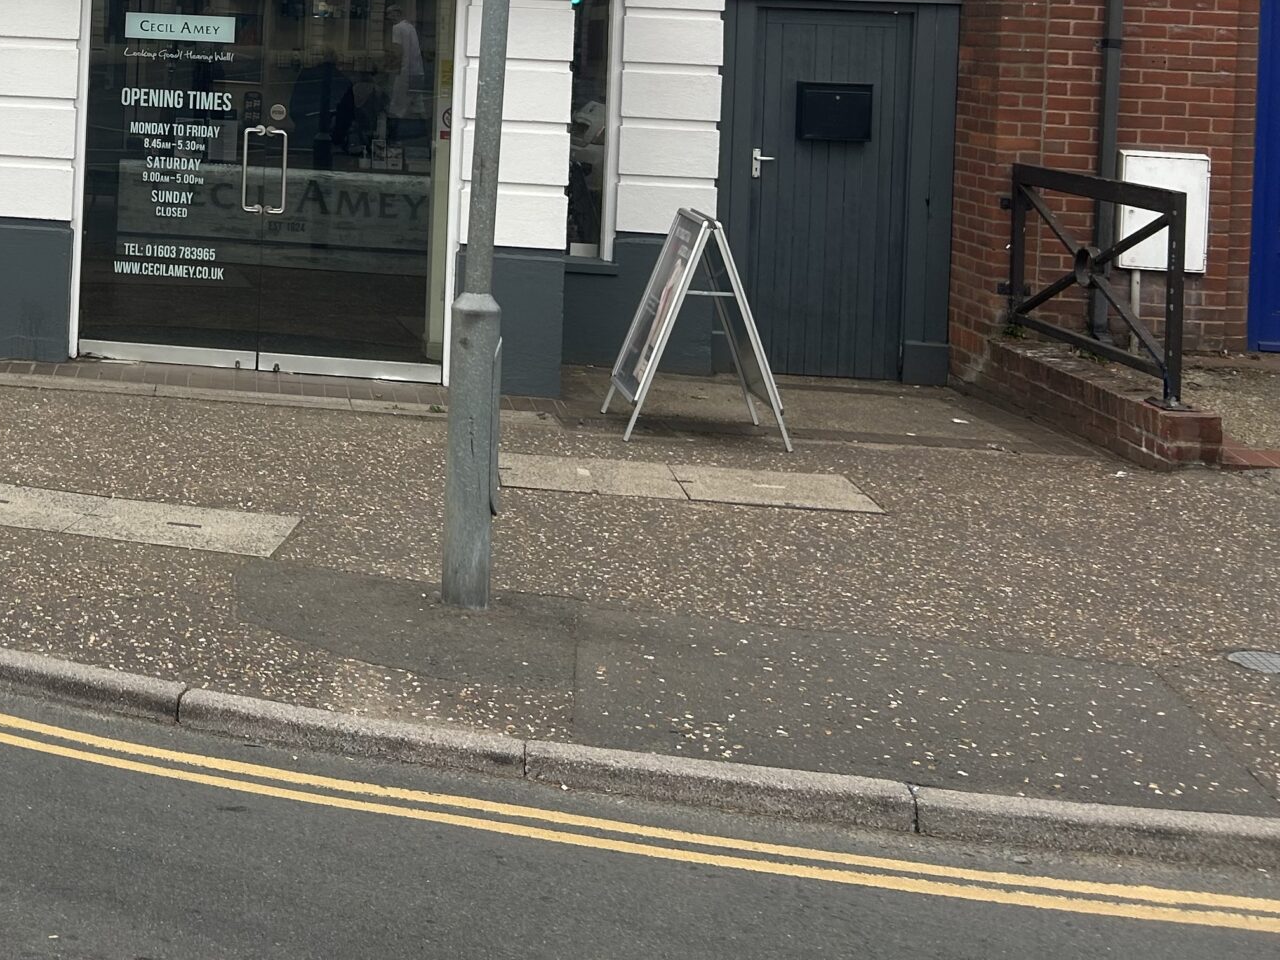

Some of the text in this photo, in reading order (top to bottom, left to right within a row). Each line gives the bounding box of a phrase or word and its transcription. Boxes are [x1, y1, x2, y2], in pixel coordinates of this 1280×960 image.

[140, 20, 220, 35] CECIL AMEY
[124, 47, 157, 60] Looking
[184, 50, 213, 63] Hearing
[121, 87, 183, 108] OPENING
[187, 90, 232, 111] TIMES
[130, 121, 220, 138] MONDAY TO FRIDAY
[146, 156, 201, 171] SATURDAY
[151, 189, 193, 205] SUNDAY
[155, 206, 188, 218] CLOSED
[124, 242, 216, 261] TEL: 01603 783965
[114, 260, 224, 280] WWW.CECILAMEY.CO.UK
